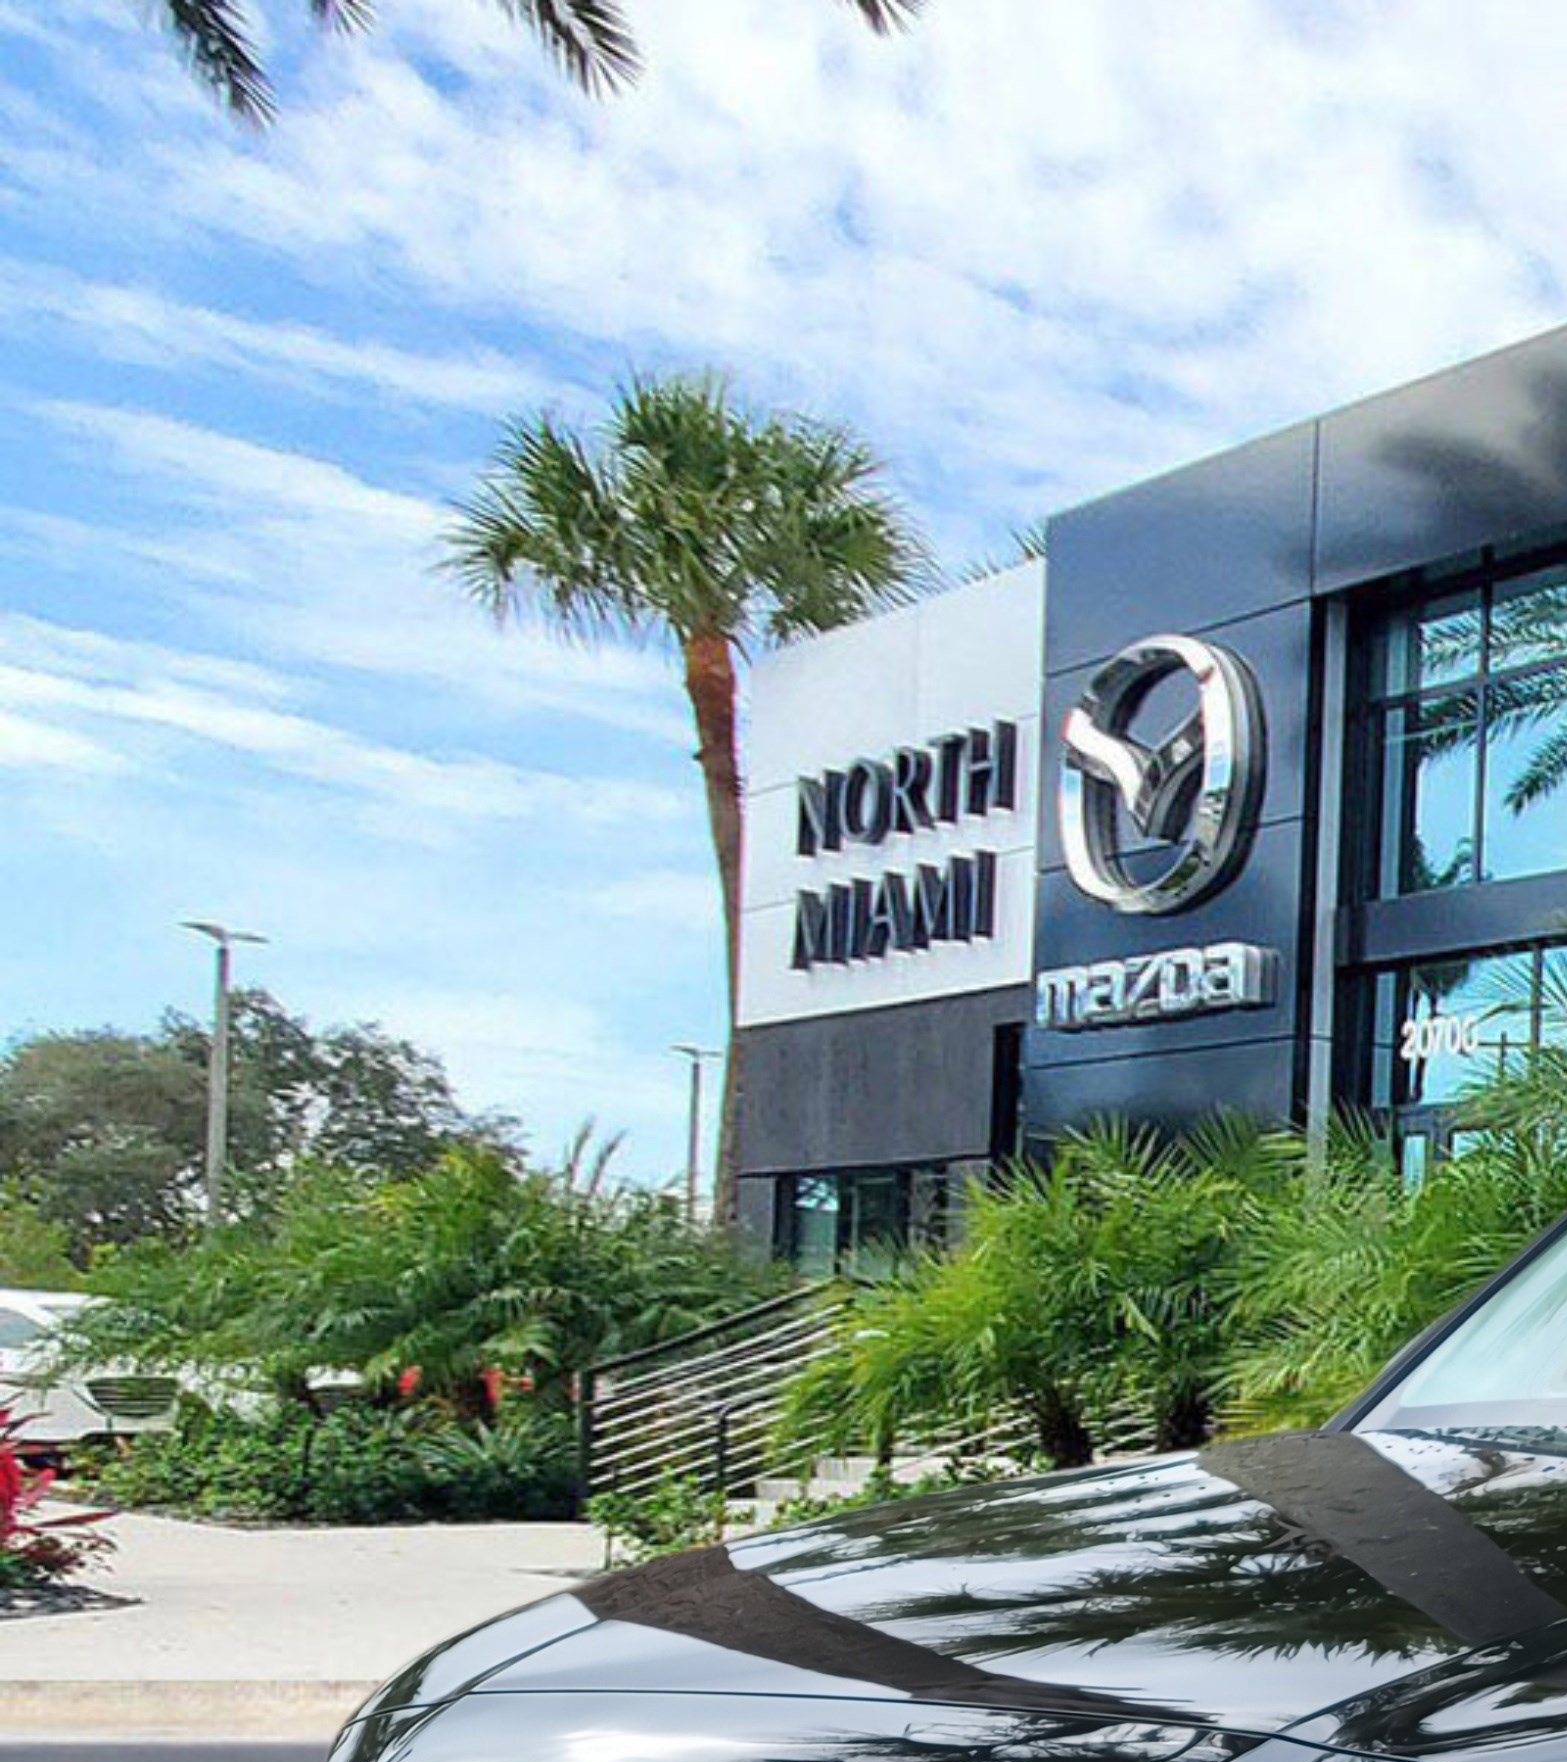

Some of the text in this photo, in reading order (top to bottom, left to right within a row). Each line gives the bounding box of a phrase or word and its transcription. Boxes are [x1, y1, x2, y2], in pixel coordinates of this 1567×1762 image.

[795, 717, 1018, 857] NORTH
[790, 849, 997, 970] MIAMI
[1035, 941, 1272, 1027] mazda
[1400, 1016, 1479, 1059] 20700
